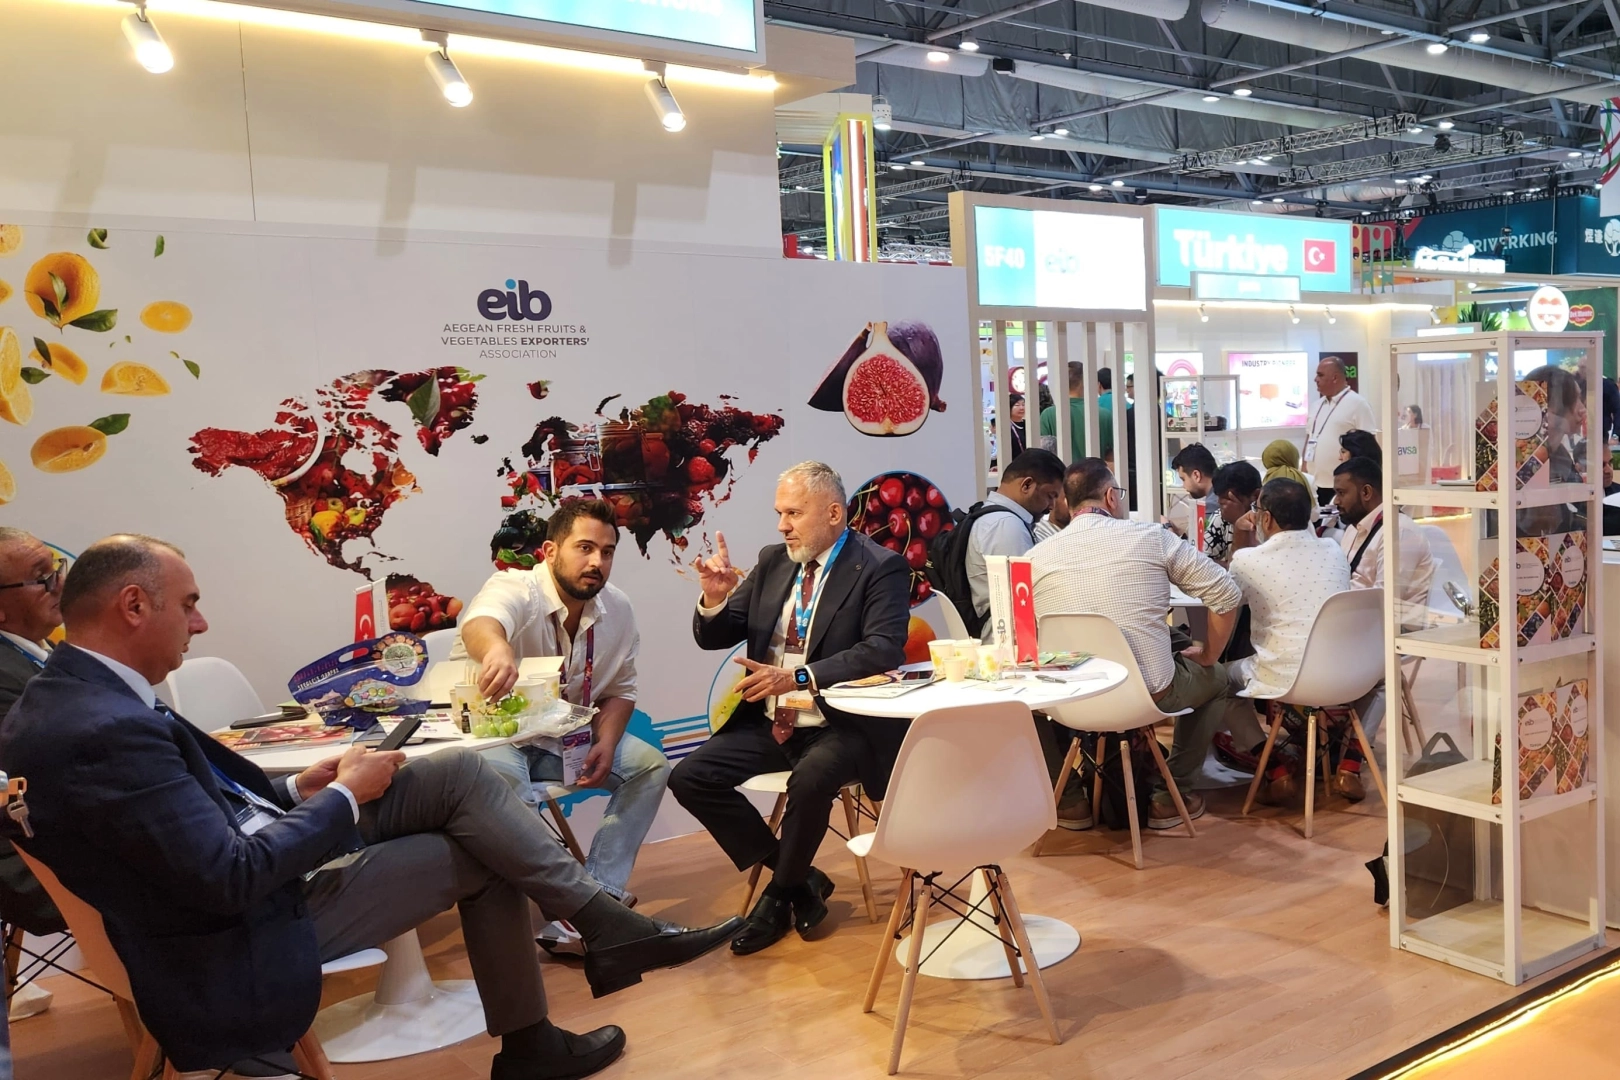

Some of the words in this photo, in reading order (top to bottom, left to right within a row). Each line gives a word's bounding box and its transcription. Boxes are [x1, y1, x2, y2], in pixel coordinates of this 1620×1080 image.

[1173, 228, 1289, 275] Türkiye
[477, 278, 552, 321] eib
[443, 324, 493, 333] AEGEAN
[497, 324, 534, 333] FRESH
[537, 325, 576, 334] FRUITS
[579, 326, 587, 334] &
[441, 337, 518, 346] VEGETABLES
[479, 350, 557, 359] ASSOCIATION
